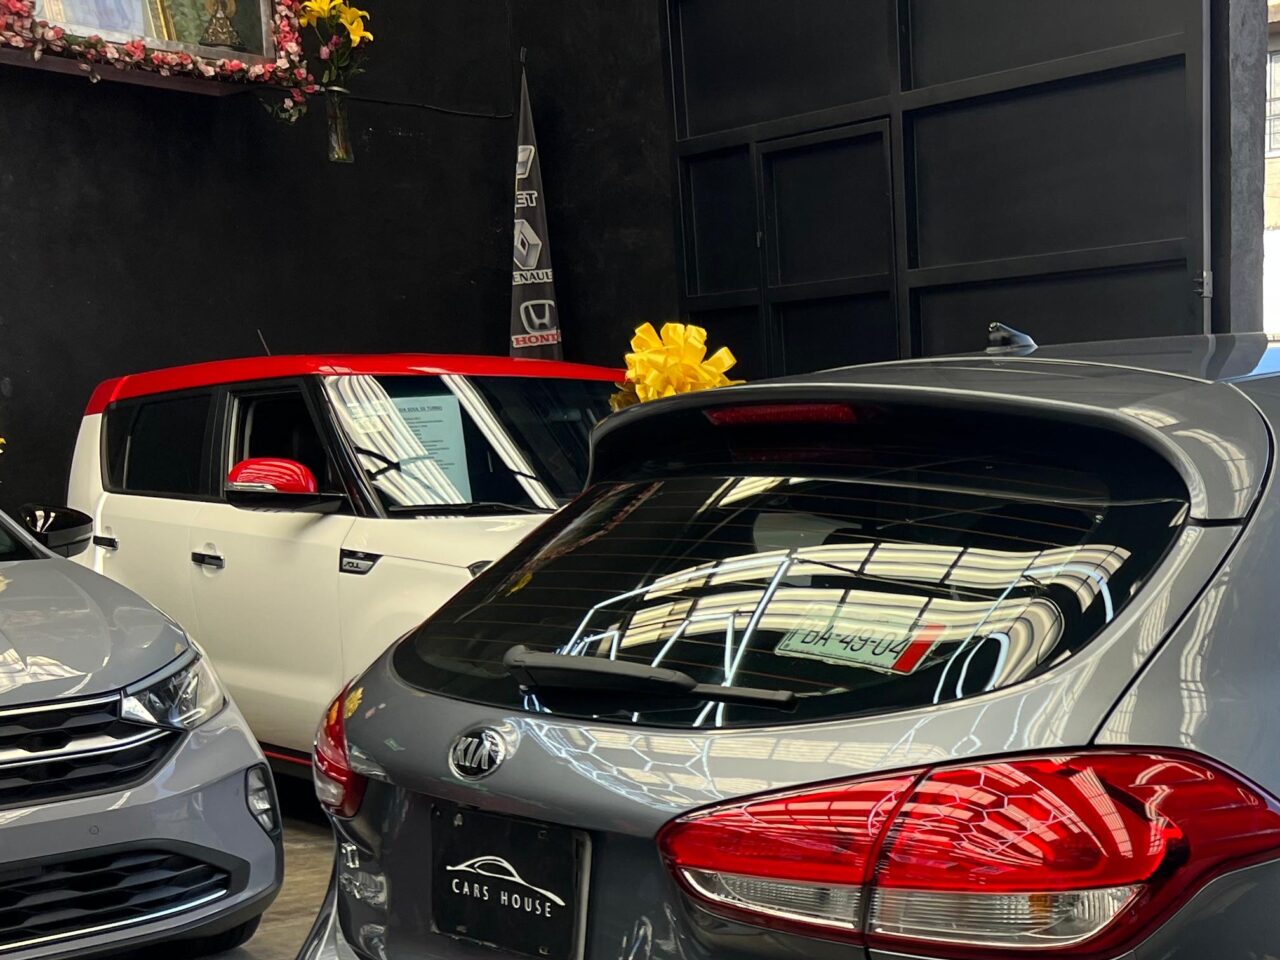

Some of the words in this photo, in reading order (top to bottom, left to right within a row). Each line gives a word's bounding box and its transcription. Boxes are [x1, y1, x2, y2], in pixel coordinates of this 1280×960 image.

[453, 733, 491, 770] KIA
[452, 878, 490, 901] CARS
[501, 890, 552, 918] HOUSE
